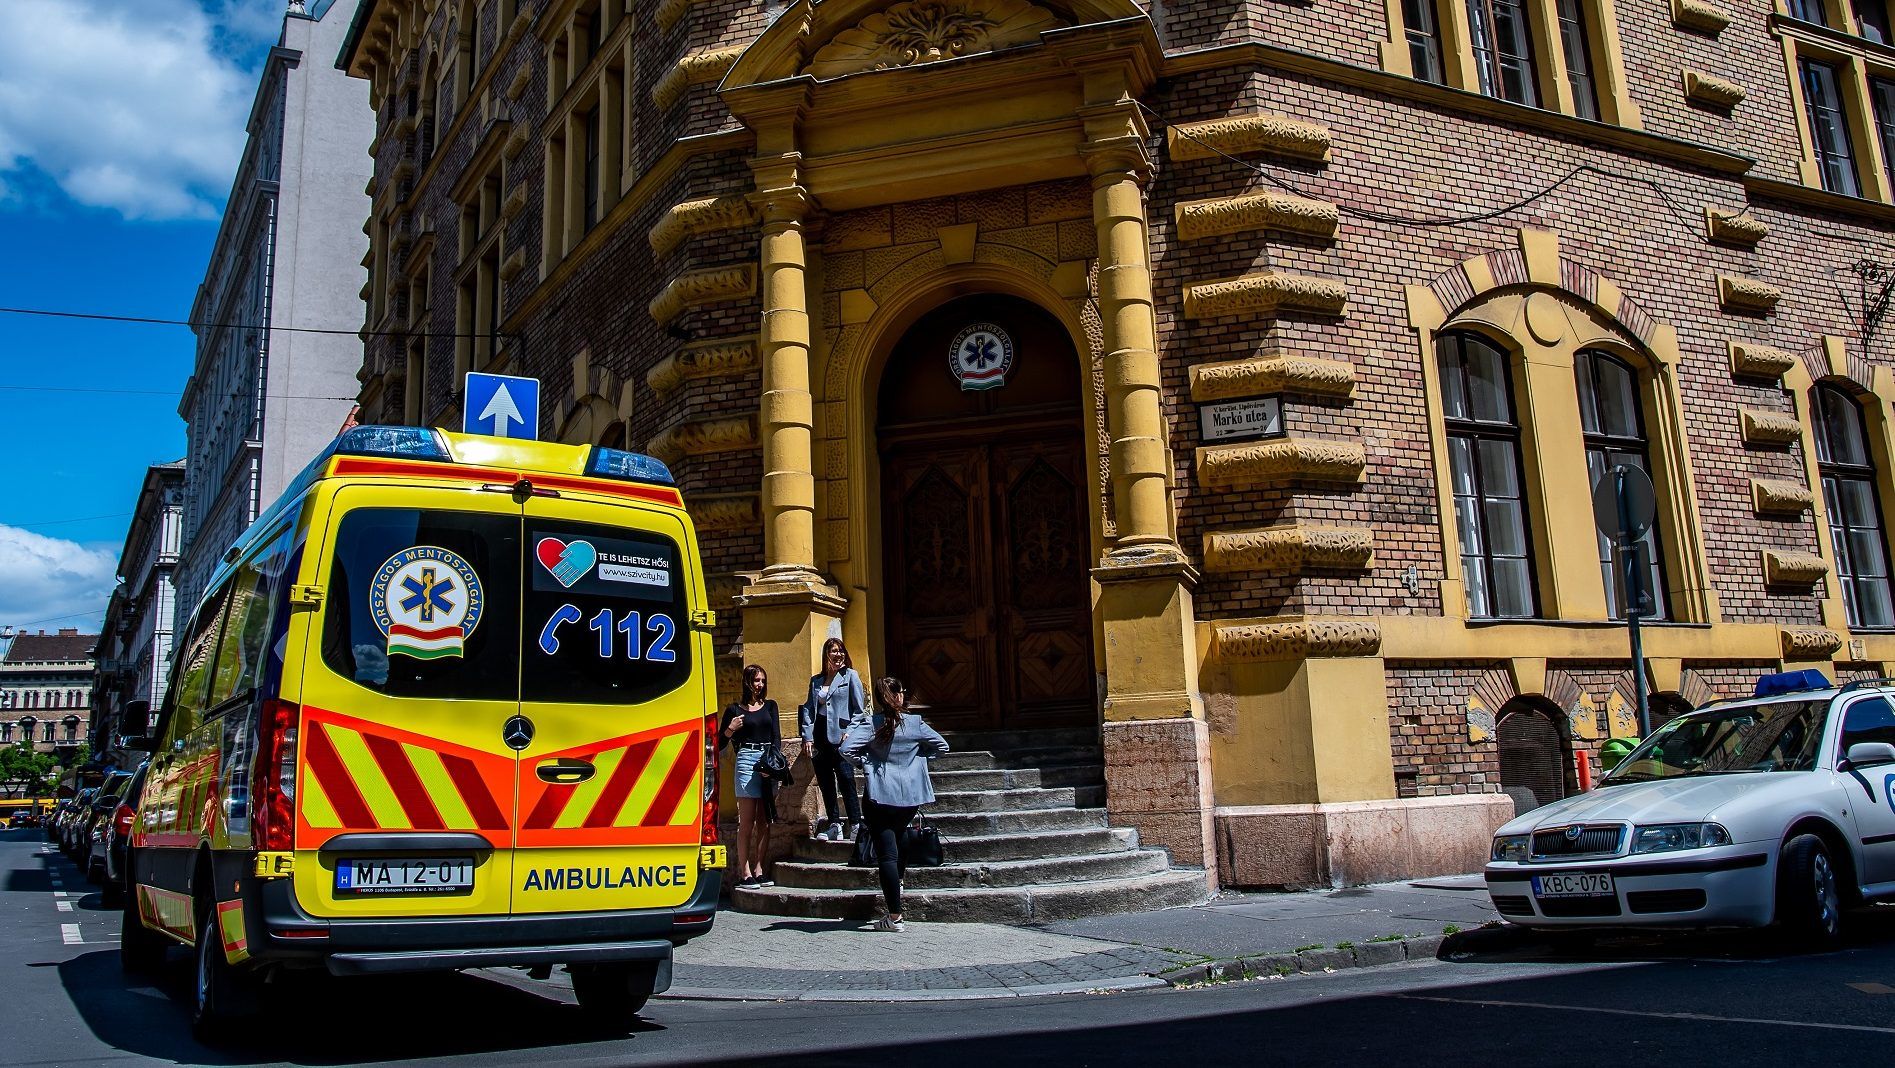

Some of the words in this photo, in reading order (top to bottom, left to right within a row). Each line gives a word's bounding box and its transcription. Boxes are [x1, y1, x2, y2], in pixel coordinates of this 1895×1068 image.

[1213, 412, 1243, 427] Markó
[1246, 410, 1267, 423] utca
[598, 552, 609, 561] TE
[610, 554, 617, 562] IS
[618, 555, 650, 566] LEHETSZ
[652, 557, 669, 568] HŐS!
[602, 567, 666, 582] www.szivcity.hu
[375, 559, 402, 626] ORSZÁGOS
[405, 549, 482, 629] MENTŐSZOLGÁLAT
[590, 608, 676, 662] 112
[341, 876, 348, 884] H
[357, 862, 392, 885] MA
[400, 861, 464, 884] 12-01
[523, 865, 687, 891] AMBULANCE
[1542, 875, 1609, 893] KBC-076
